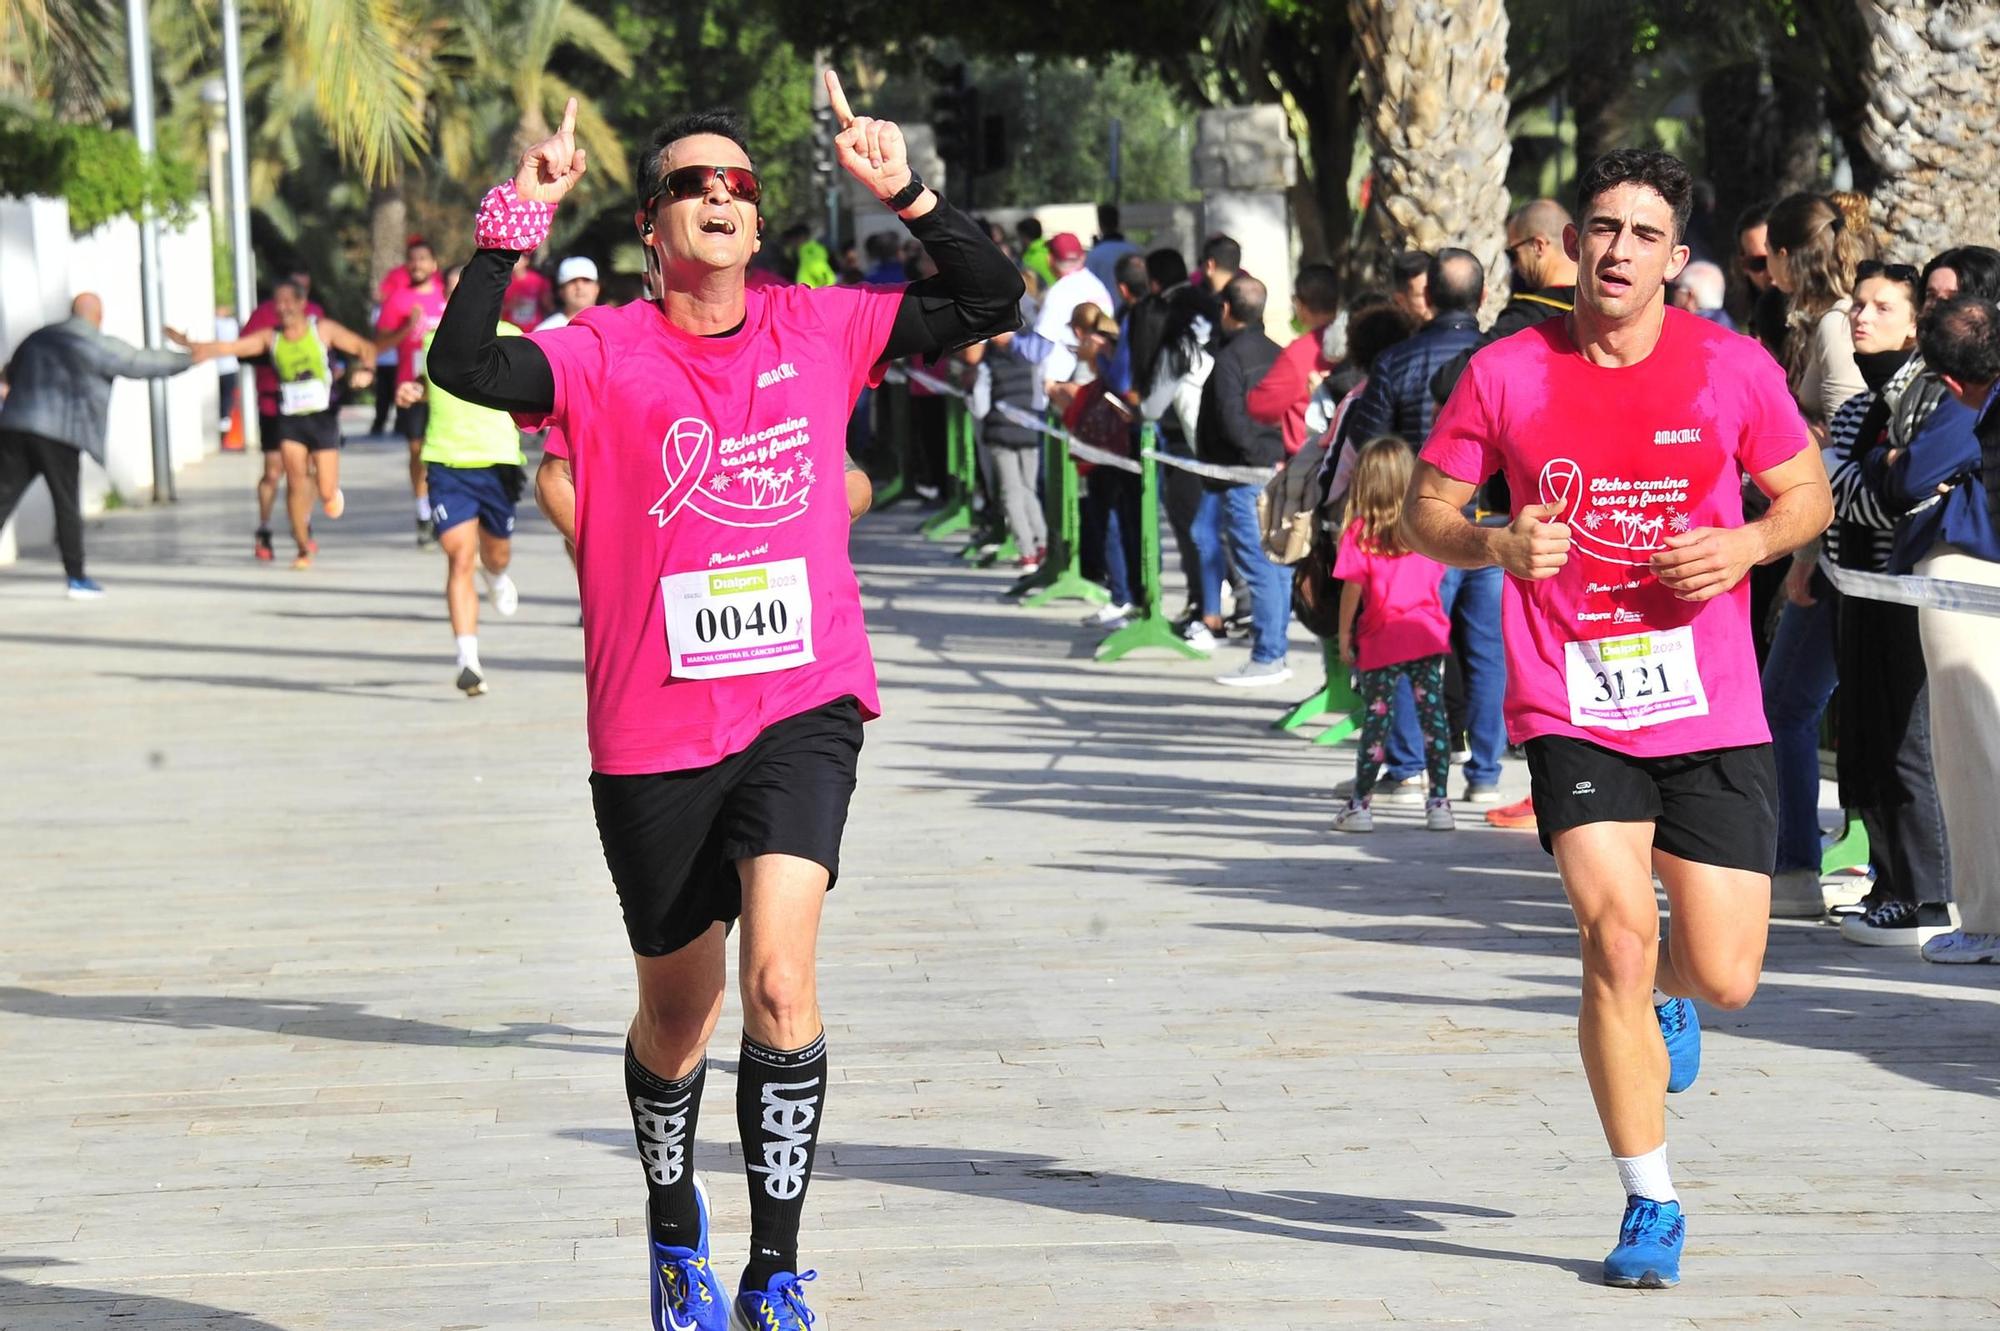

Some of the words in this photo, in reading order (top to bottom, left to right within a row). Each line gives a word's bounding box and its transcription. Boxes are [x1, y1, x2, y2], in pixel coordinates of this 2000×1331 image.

[718, 432, 757, 455] Elche
[757, 417, 809, 441] camina
[1653, 428, 1702, 445] AMACMEC
[721, 451, 757, 467] rosa
[757, 446, 768, 463] y
[769, 430, 810, 459] fuerte
[1589, 477, 1632, 492] Elche
[1633, 476, 1690, 490] camina
[1591, 495, 1628, 507] rosa
[1628, 494, 1640, 509] y
[1640, 489, 1688, 509] fuerte
[770, 575, 797, 588] 2023
[695, 599, 788, 643] 0040
[686, 654, 714, 664] MARCHA
[714, 652, 741, 661] CONTRA
[1594, 663, 1671, 702] 3121
[747, 1044, 786, 1062] SOCKS
[748, 1076, 820, 1200] eleven
